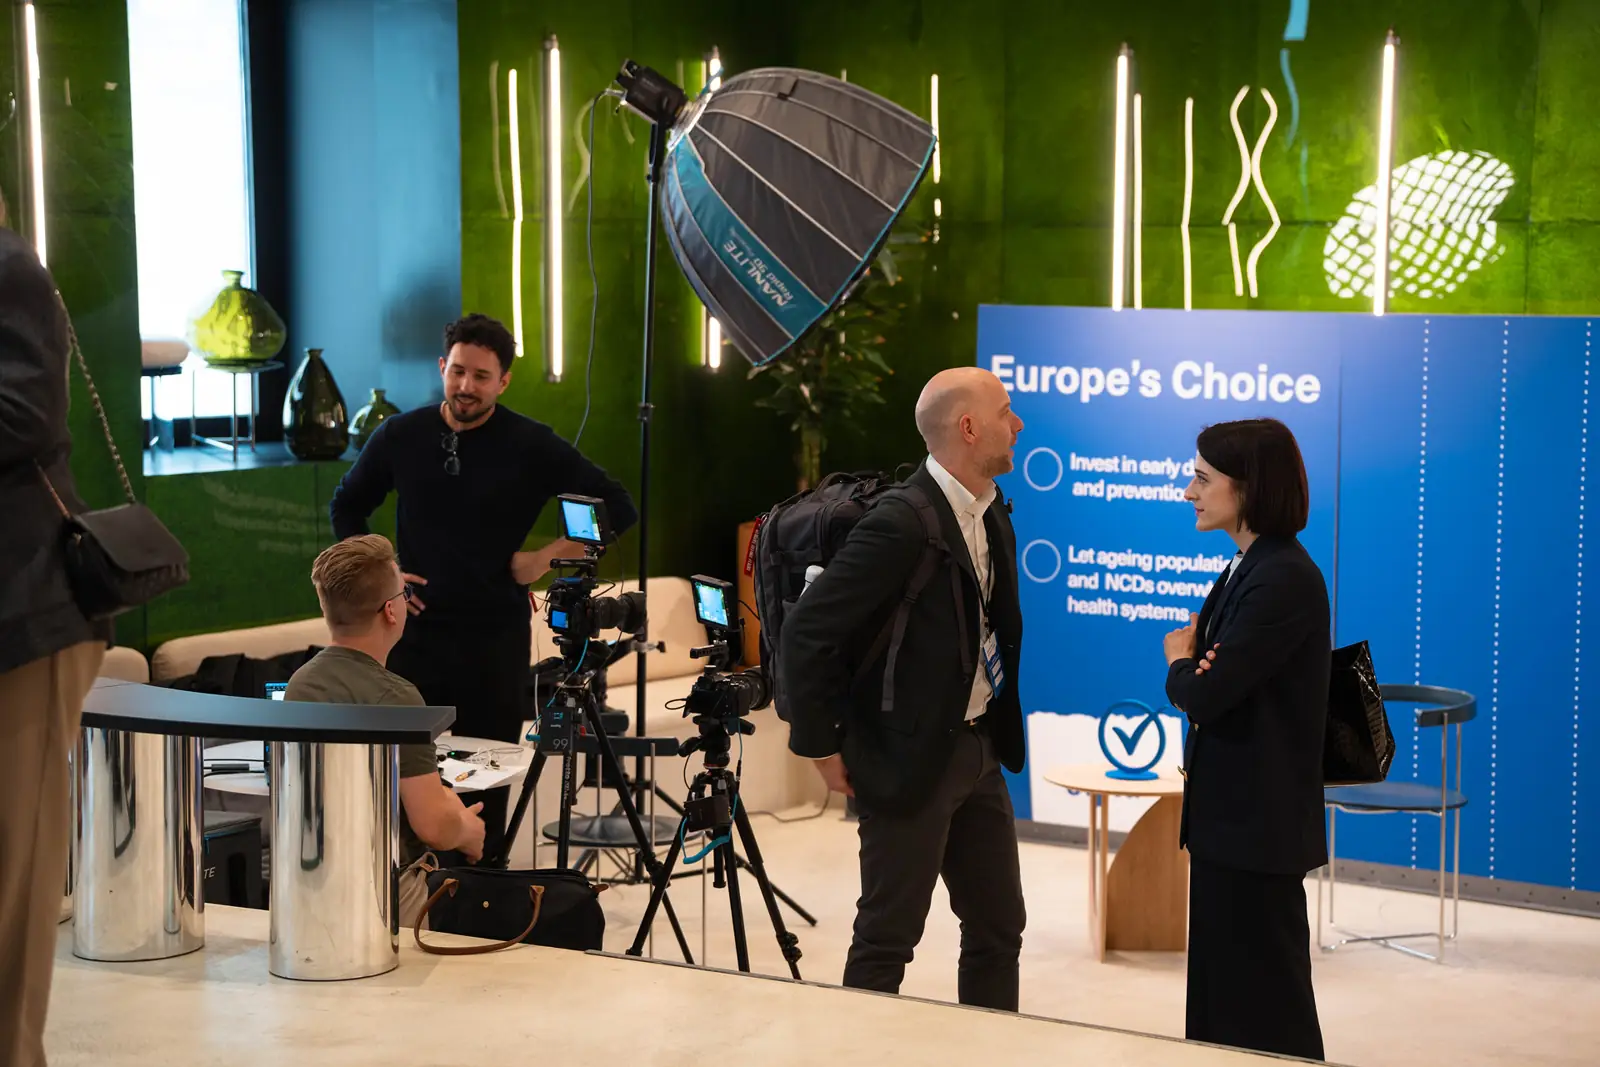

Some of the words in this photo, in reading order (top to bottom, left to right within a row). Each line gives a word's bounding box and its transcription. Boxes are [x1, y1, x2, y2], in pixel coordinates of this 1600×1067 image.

[724, 240, 788, 306] NANLITE
[991, 354, 1162, 404] Europe's
[1172, 360, 1322, 404] Choice
[1070, 452, 1120, 473] Invest
[1121, 455, 1137, 474] in
[1139, 457, 1181, 480] early
[1181, 458, 1196, 476] d
[1072, 478, 1104, 497] and
[1106, 483, 1188, 502] preventio
[1068, 545, 1095, 564] Let
[1096, 549, 1153, 571] ageing
[1155, 553, 1231, 574] populati
[1067, 572, 1099, 590] and
[1104, 572, 1154, 595] NCDs
[1156, 580, 1213, 598] overw
[1066, 595, 1118, 617] health
[1120, 602, 1190, 622] systems
[553, 738, 569, 750] 99
